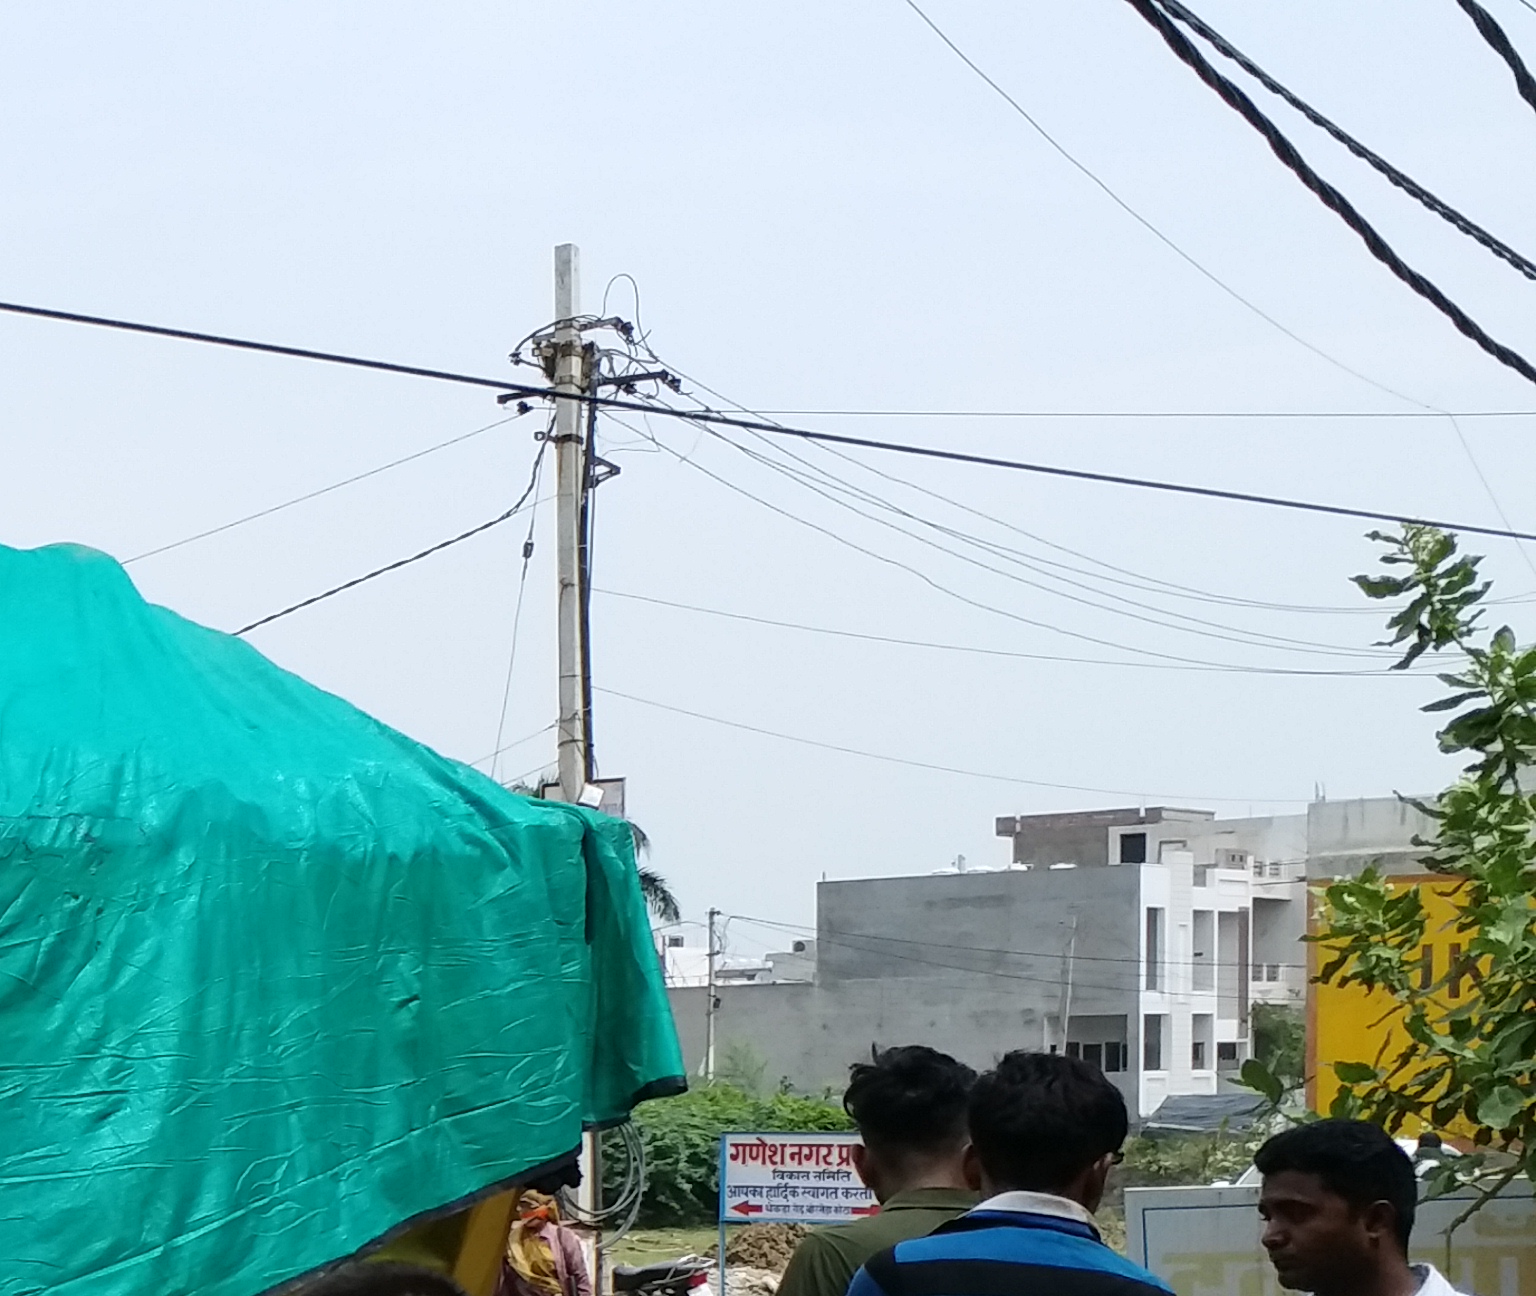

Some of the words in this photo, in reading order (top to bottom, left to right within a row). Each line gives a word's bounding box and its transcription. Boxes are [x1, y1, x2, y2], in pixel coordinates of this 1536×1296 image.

[730, 1137, 787, 1166] गणेश
[789, 1144, 834, 1166] नगर
[727, 1185, 763, 1199] आपका
[765, 1183, 800, 1202] हार्दिक
[801, 1186, 838, 1200] स्वागत
